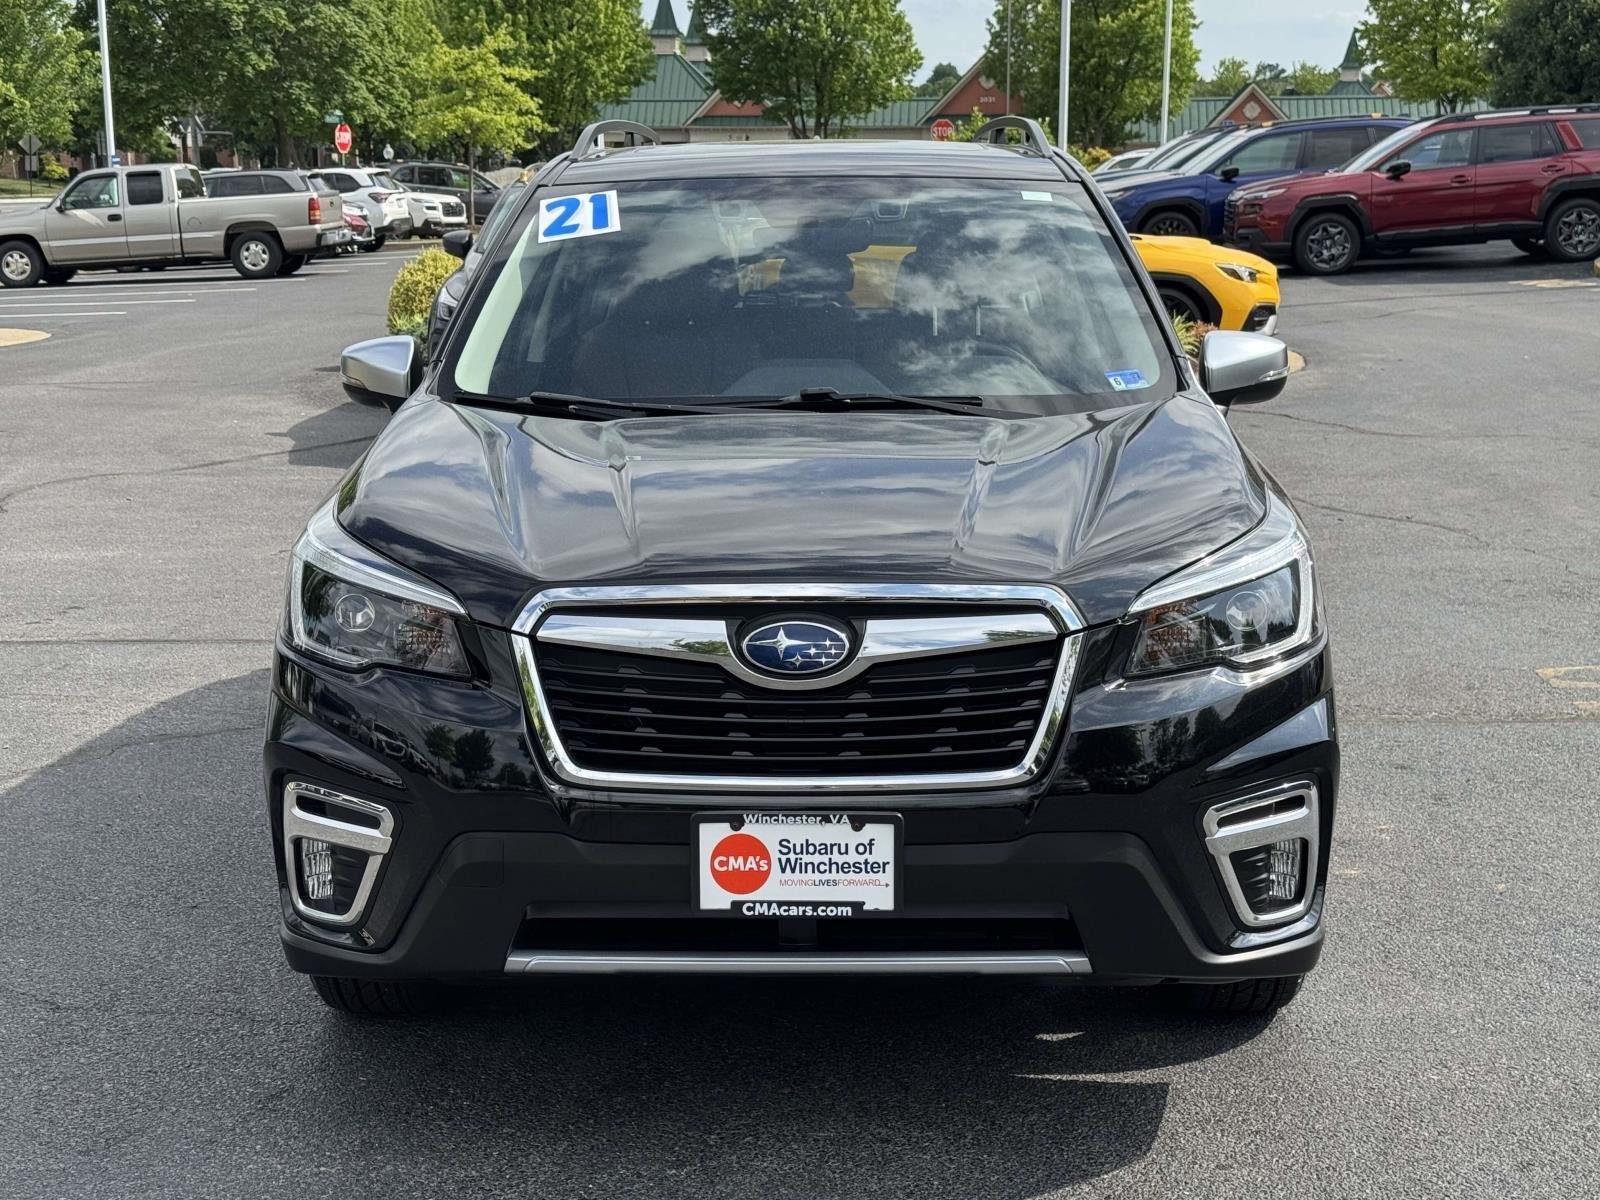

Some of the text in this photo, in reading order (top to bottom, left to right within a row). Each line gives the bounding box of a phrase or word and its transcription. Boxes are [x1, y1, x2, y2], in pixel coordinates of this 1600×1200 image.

[933, 127, 953, 138] STOP
[543, 193, 609, 238] 21
[743, 814, 850, 826] Winchester, VA
[778, 838, 876, 856] Subaru of
[713, 855, 769, 872] CMA's
[778, 857, 890, 874] Winchester
[742, 902, 852, 917] CMAcars.com
